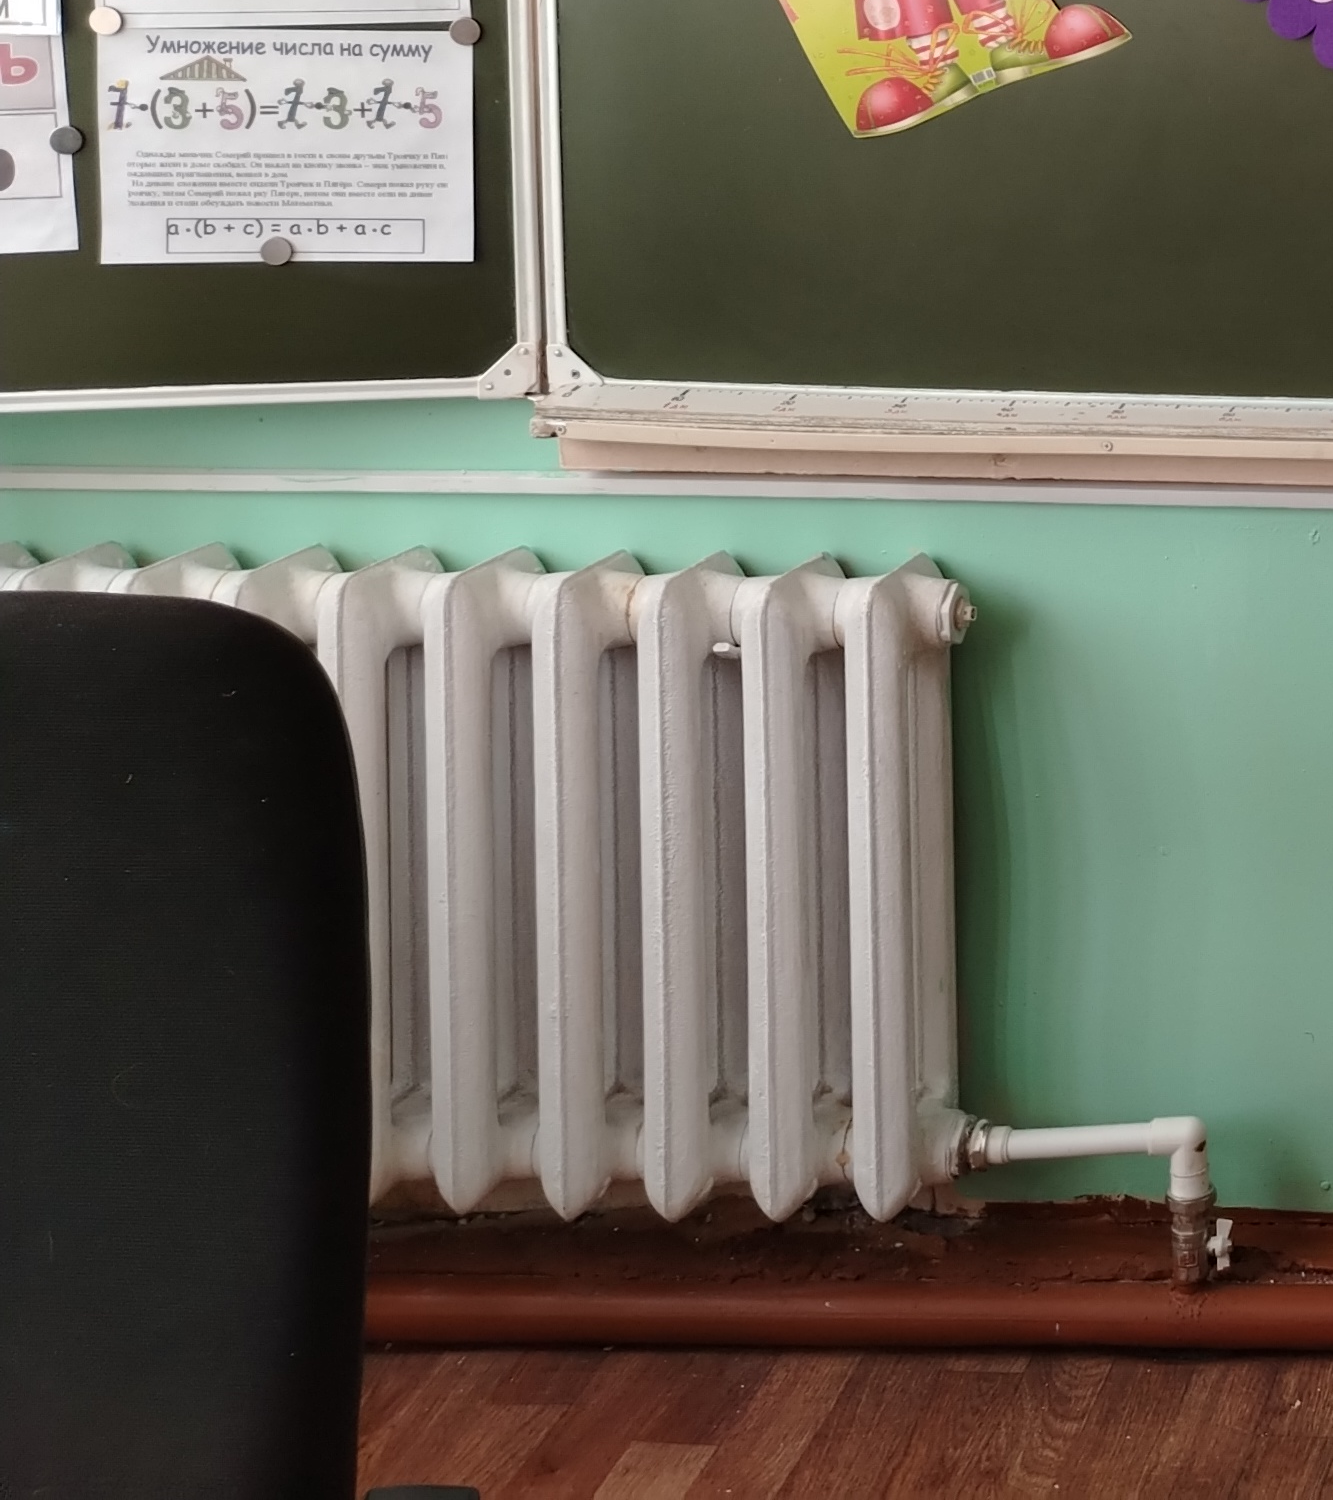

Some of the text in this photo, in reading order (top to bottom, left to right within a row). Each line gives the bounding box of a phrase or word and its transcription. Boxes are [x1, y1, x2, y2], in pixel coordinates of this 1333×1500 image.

[146, 35, 432, 63] Умножение числа на сумму
